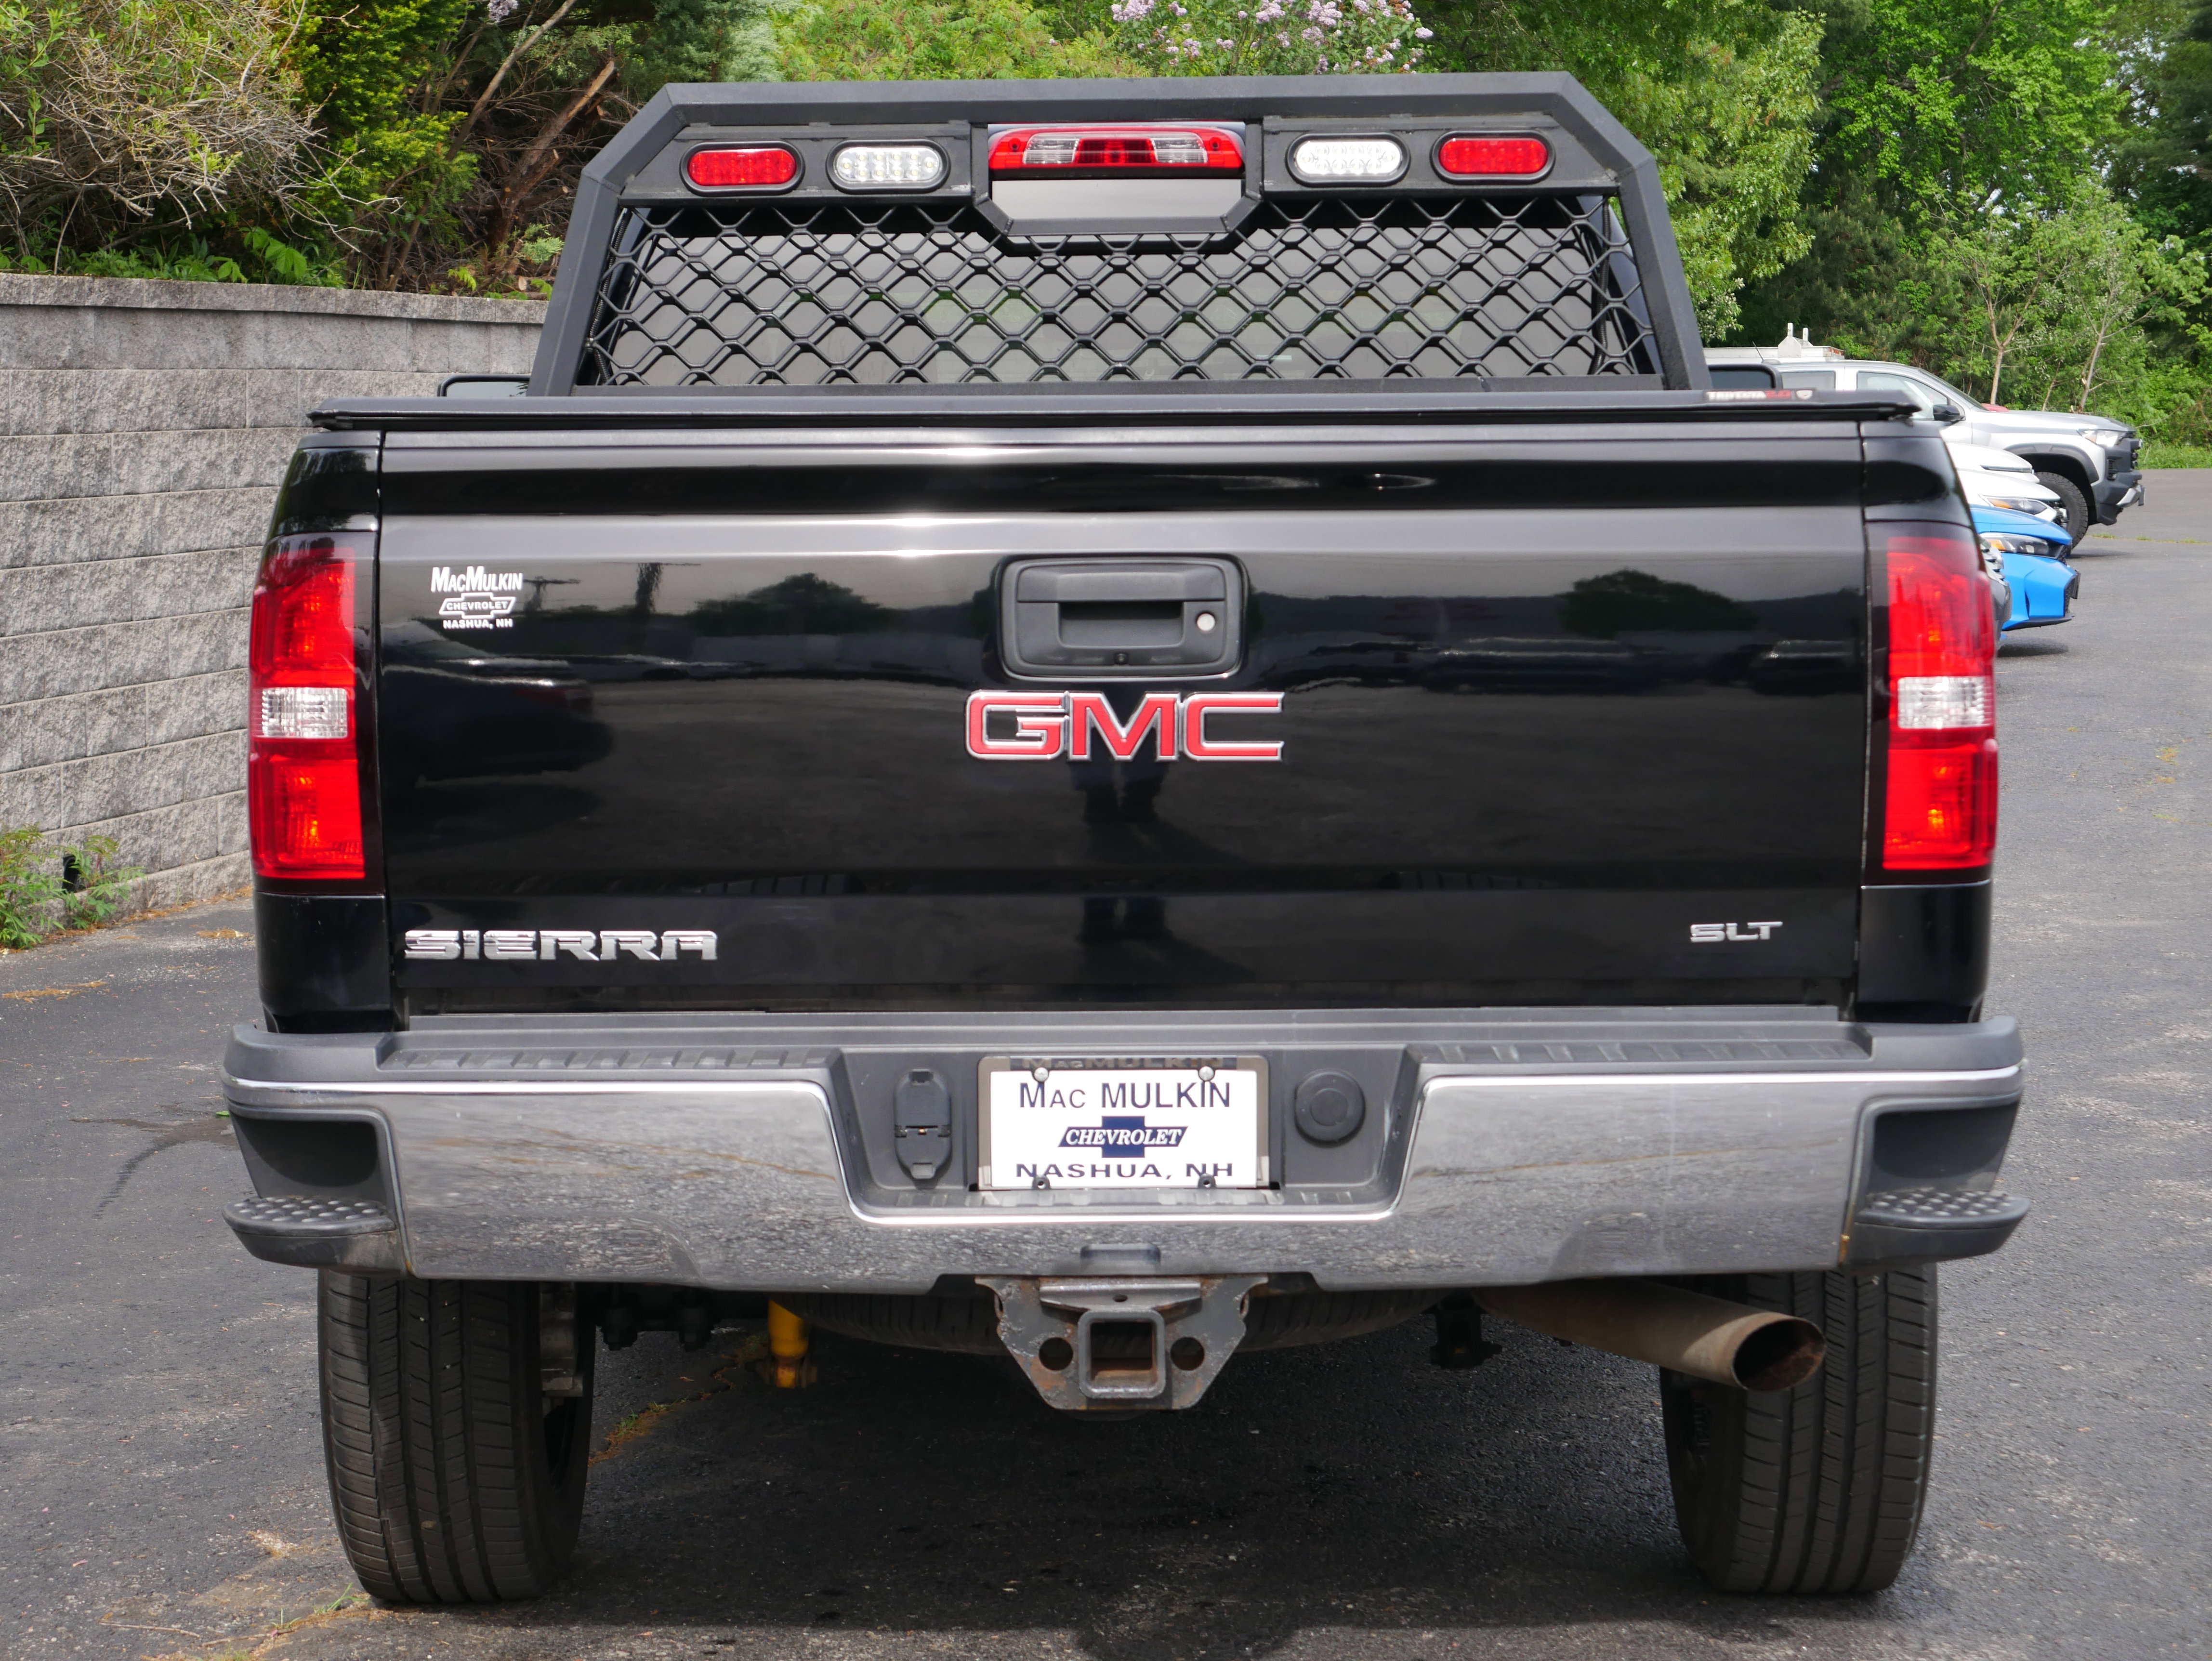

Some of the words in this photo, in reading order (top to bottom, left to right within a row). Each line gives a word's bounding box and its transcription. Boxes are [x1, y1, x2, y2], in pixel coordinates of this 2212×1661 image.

[446, 601, 509, 610] CHEVROLET
[443, 619, 494, 629] NASHUA,
[496, 619, 513, 627] NH
[965, 690, 1285, 761] GMC
[1690, 921, 1783, 943] SLT
[405, 930, 718, 961] SIERRA
[1102, 1081, 1230, 1108] MULKIN
[1065, 1128, 1182, 1146] CHEVROLET
[1015, 1163, 1172, 1180] NASHUA,
[1185, 1163, 1233, 1177] NH
